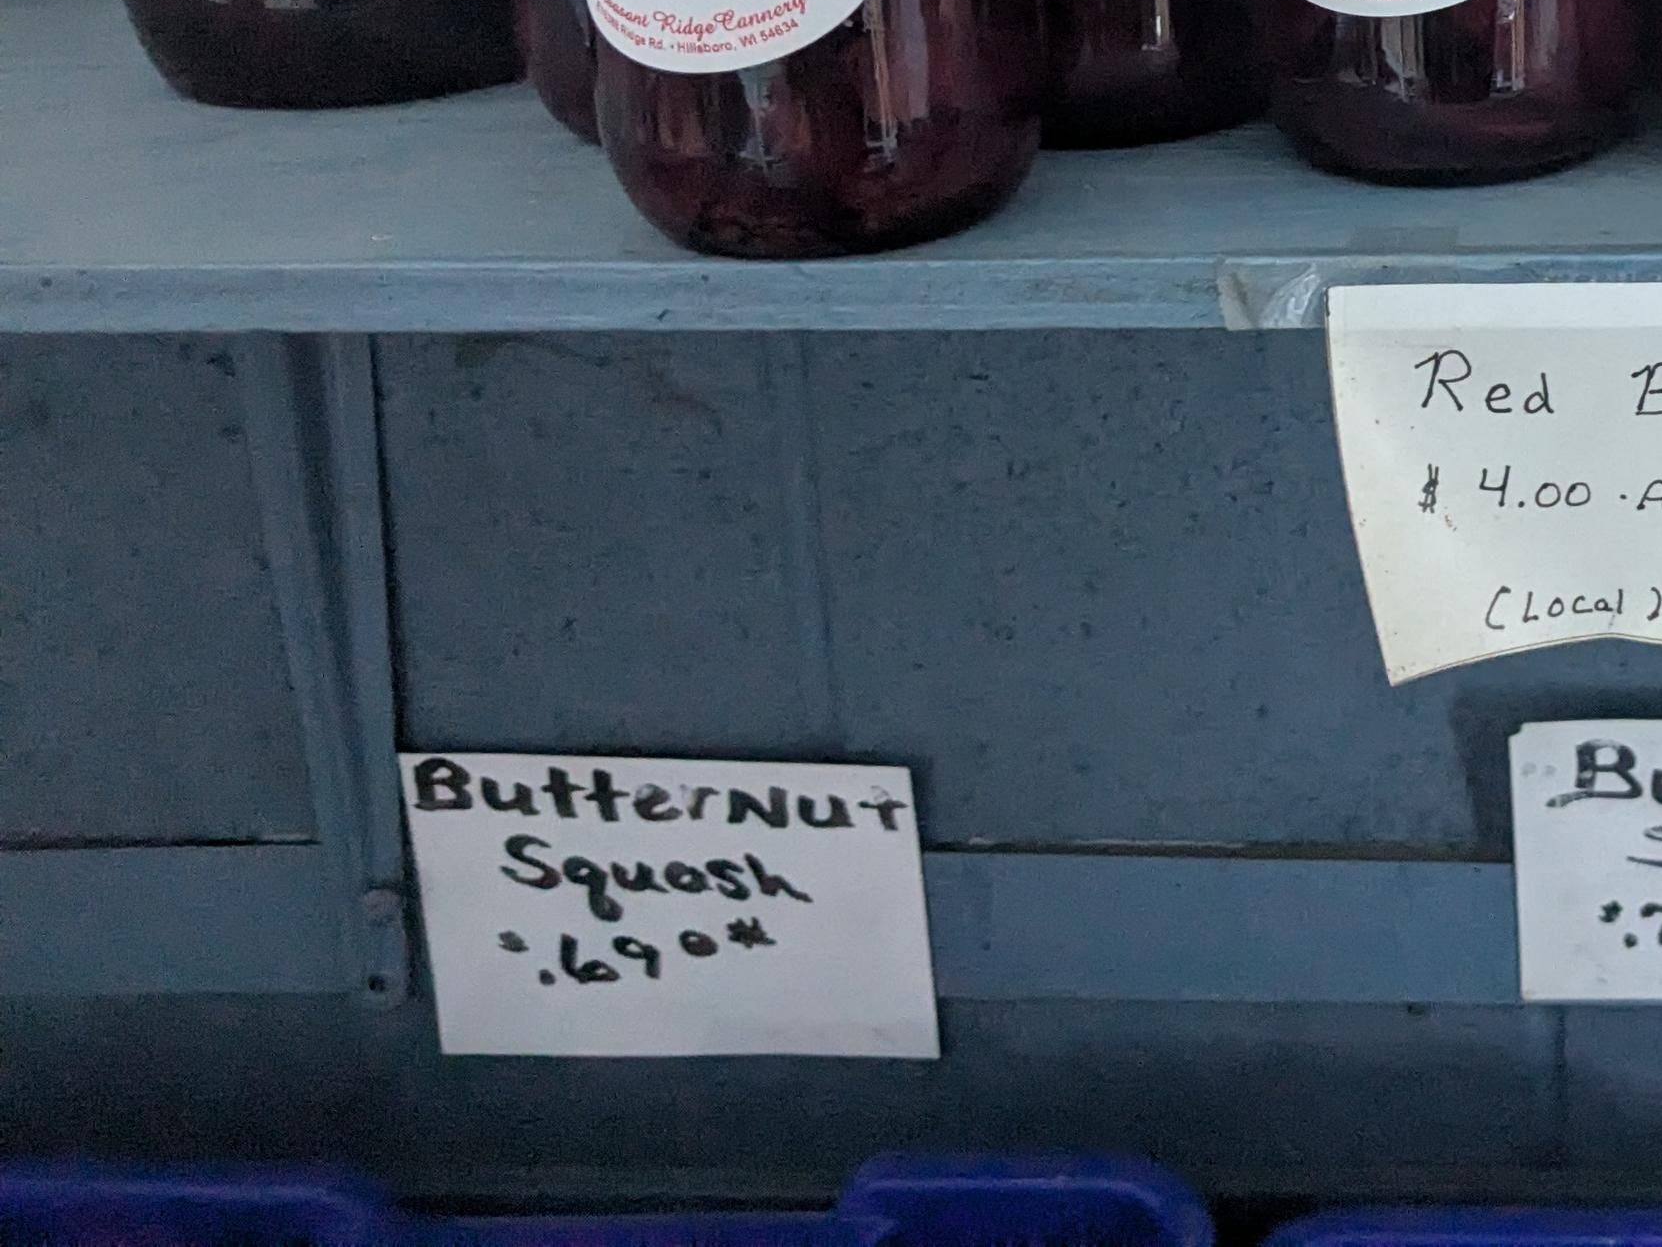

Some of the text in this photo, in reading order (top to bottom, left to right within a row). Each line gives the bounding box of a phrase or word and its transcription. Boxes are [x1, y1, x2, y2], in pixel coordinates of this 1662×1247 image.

[654, 11, 717, 41] Ridge
[740, 19, 798, 48] WI 54634
[1414, 349, 1555, 415] Red
[499, 834, 813, 922] Squash
